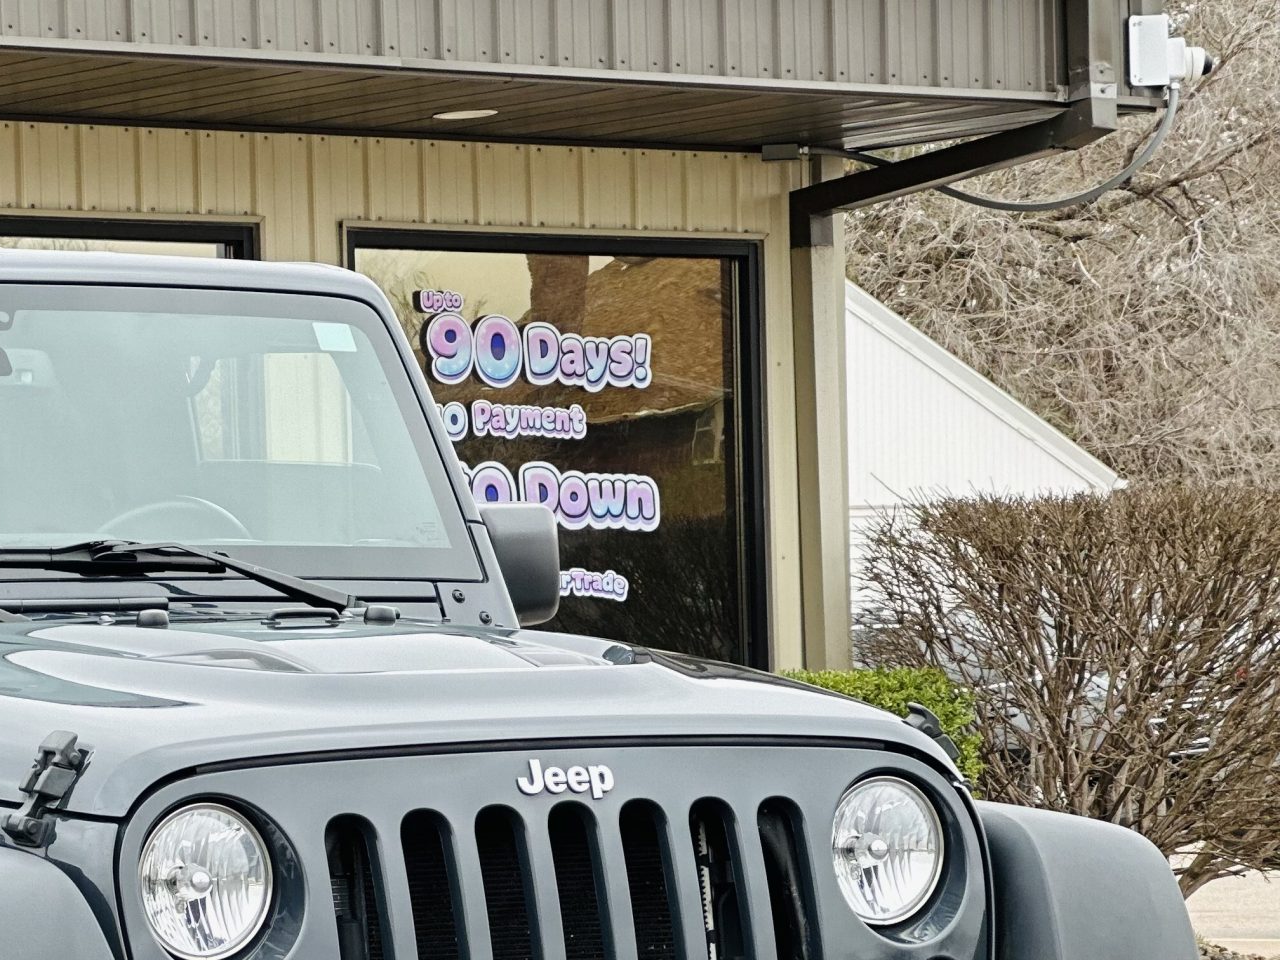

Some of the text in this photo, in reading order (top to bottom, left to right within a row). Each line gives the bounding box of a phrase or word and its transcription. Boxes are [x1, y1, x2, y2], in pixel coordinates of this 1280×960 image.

[422, 290, 462, 309] Up to
[428, 314, 649, 386] 90 Days!
[473, 401, 586, 437] Payment
[521, 464, 658, 527] Down
[570, 570, 626, 596] Trade
[516, 758, 615, 800] Jeep
